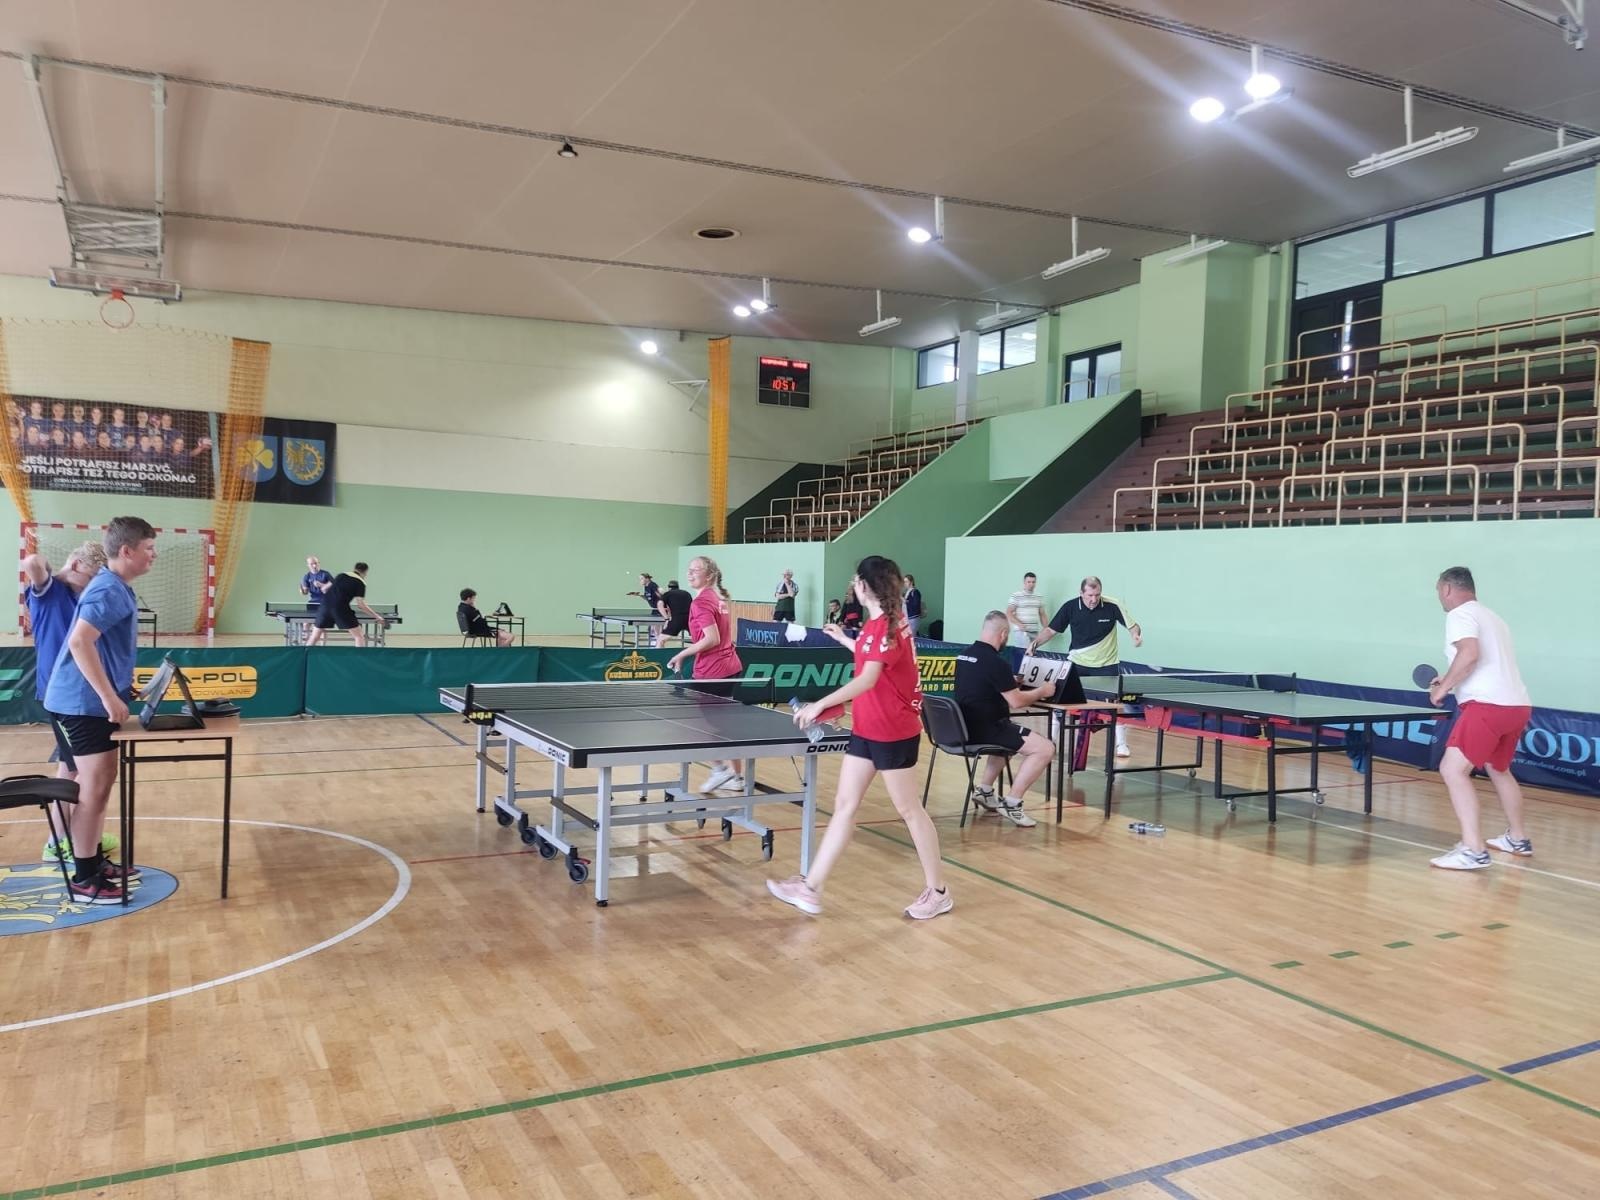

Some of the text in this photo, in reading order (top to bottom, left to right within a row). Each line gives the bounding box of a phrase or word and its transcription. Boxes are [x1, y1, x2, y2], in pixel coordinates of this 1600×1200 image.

[21, 455, 54, 466] JEŚLI
[56, 457, 121, 470] POTRAFISZ
[83, 466, 104, 478] TEŻ
[105, 469, 137, 480] TEGO
[138, 471, 197, 484] DOKONAĆ
[745, 628, 779, 644] MODEST
[1028, 666, 1039, 683] 9
